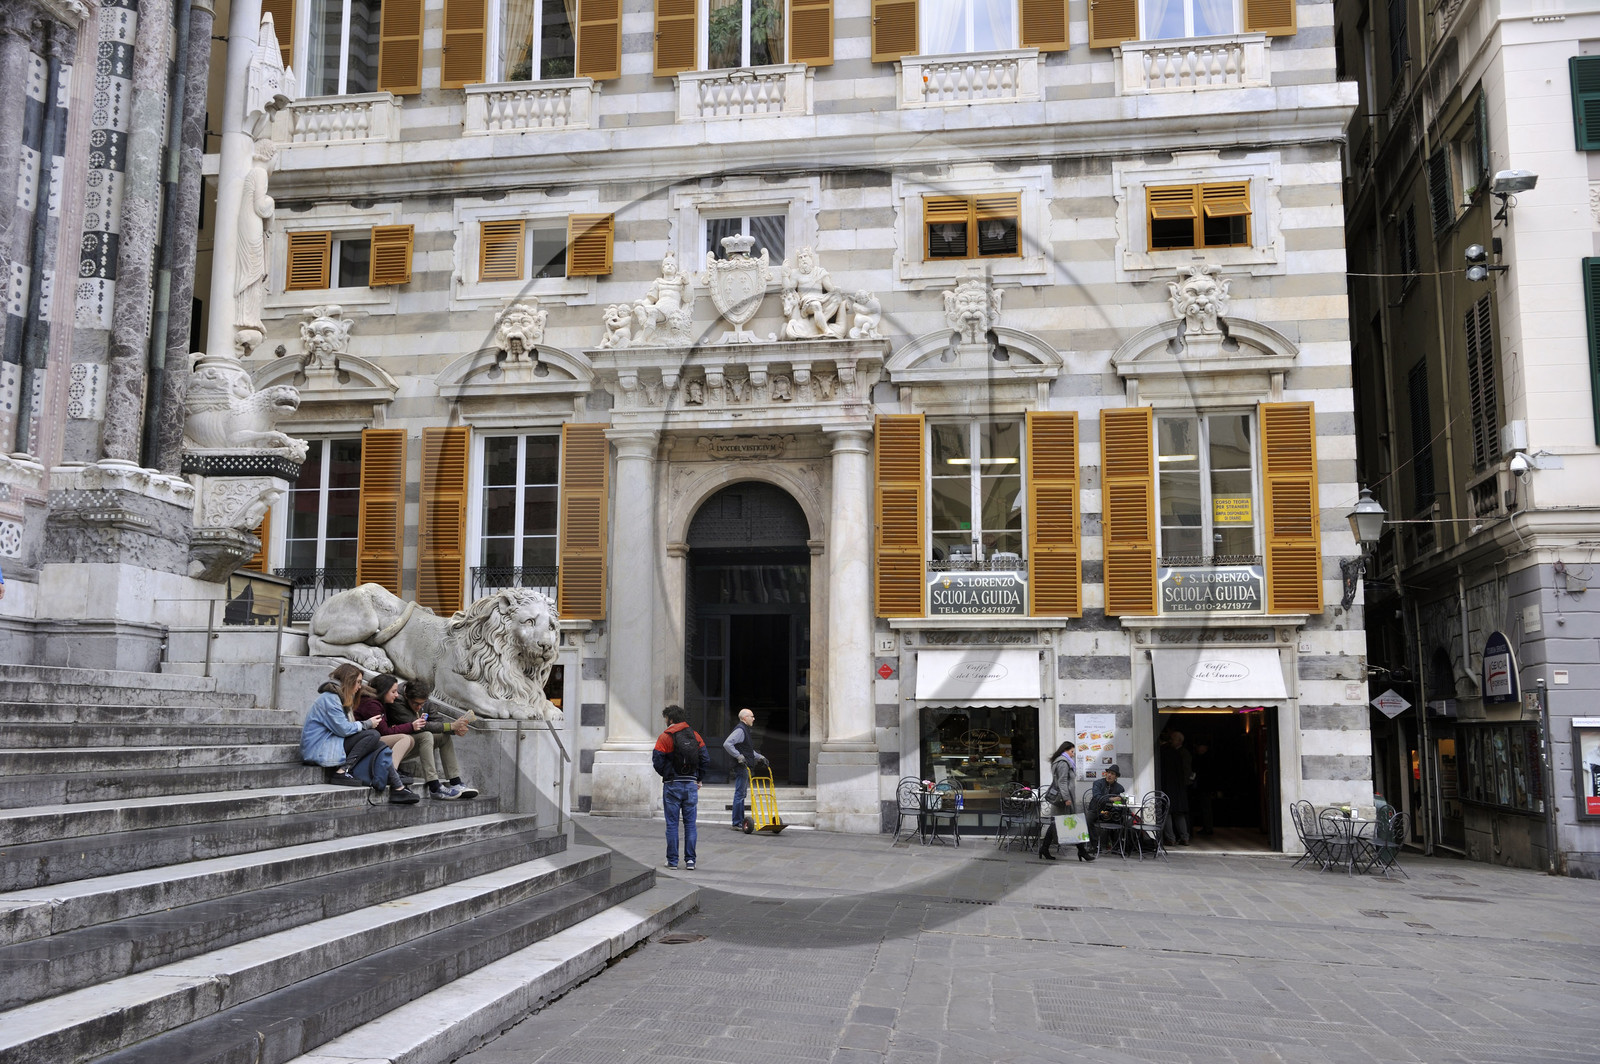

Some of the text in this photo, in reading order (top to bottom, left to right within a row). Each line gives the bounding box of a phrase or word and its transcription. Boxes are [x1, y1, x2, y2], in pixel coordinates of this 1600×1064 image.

[957, 577, 1015, 588] S. LORENZO
[1189, 572, 1250, 584] S. LORENZO
[933, 590, 1021, 605] SCUOLA GUIDA
[1165, 585, 1257, 602] SCUOLA GUIDA
[938, 606, 1016, 614] TEL. 010-2471977
[1194, 602, 1252, 610] 010-2471977
[987, 631, 1031, 644] Duomo
[1197, 630, 1217, 642] del
[1222, 629, 1269, 642] Duomo
[882, 641, 892, 649] 17
